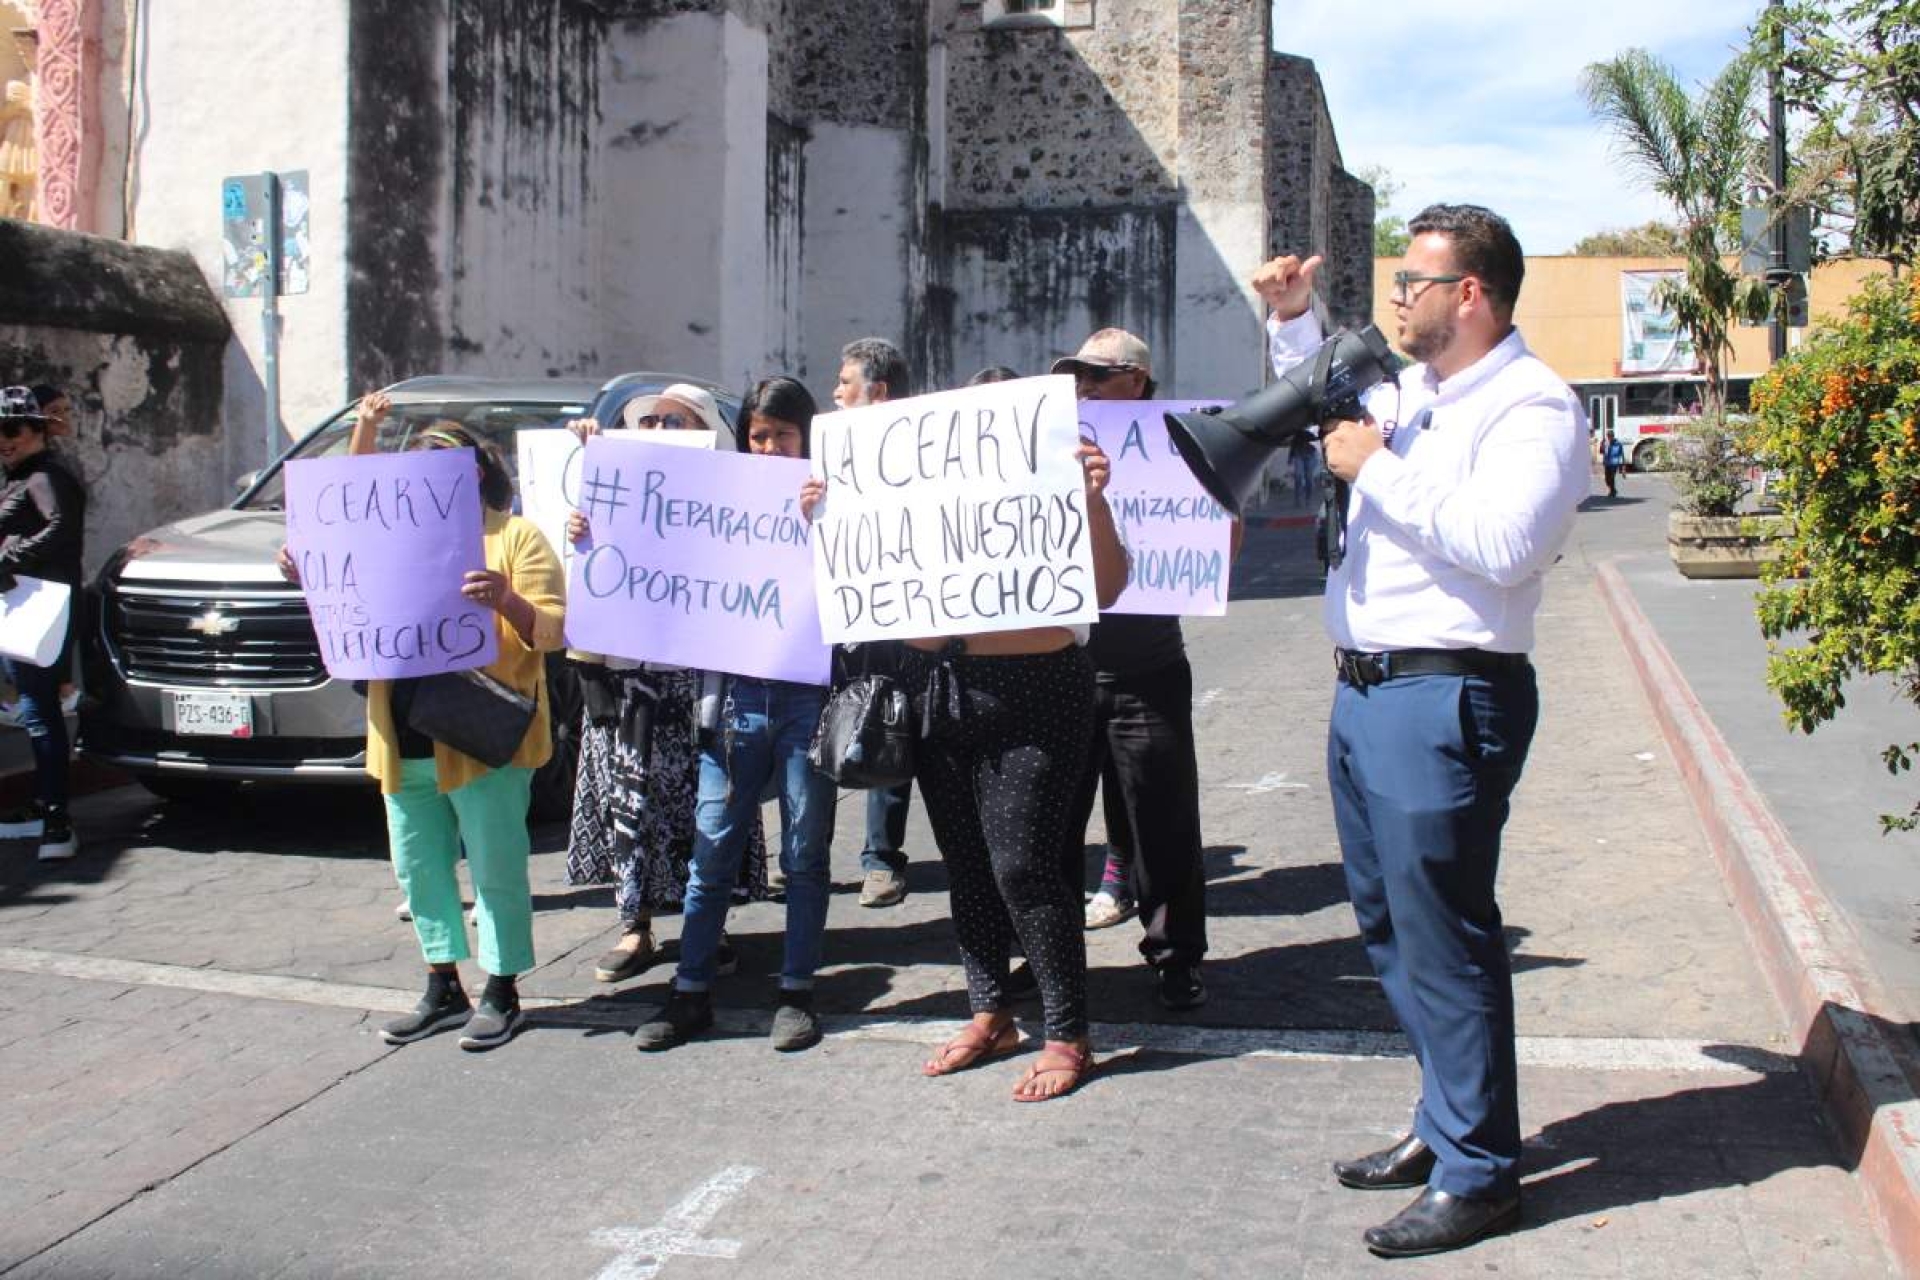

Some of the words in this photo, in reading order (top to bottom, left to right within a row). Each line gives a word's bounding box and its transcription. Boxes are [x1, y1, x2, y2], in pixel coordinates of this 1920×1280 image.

[822, 426, 862, 494] LA
[879, 394, 1046, 487] CEARV
[303, 550, 362, 600] OLA
[818, 507, 922, 579] VIOLA
[941, 489, 1083, 564] NUESTROS
[583, 544, 783, 629] OPORTUNA
[834, 565, 1084, 629] DERECHOS
